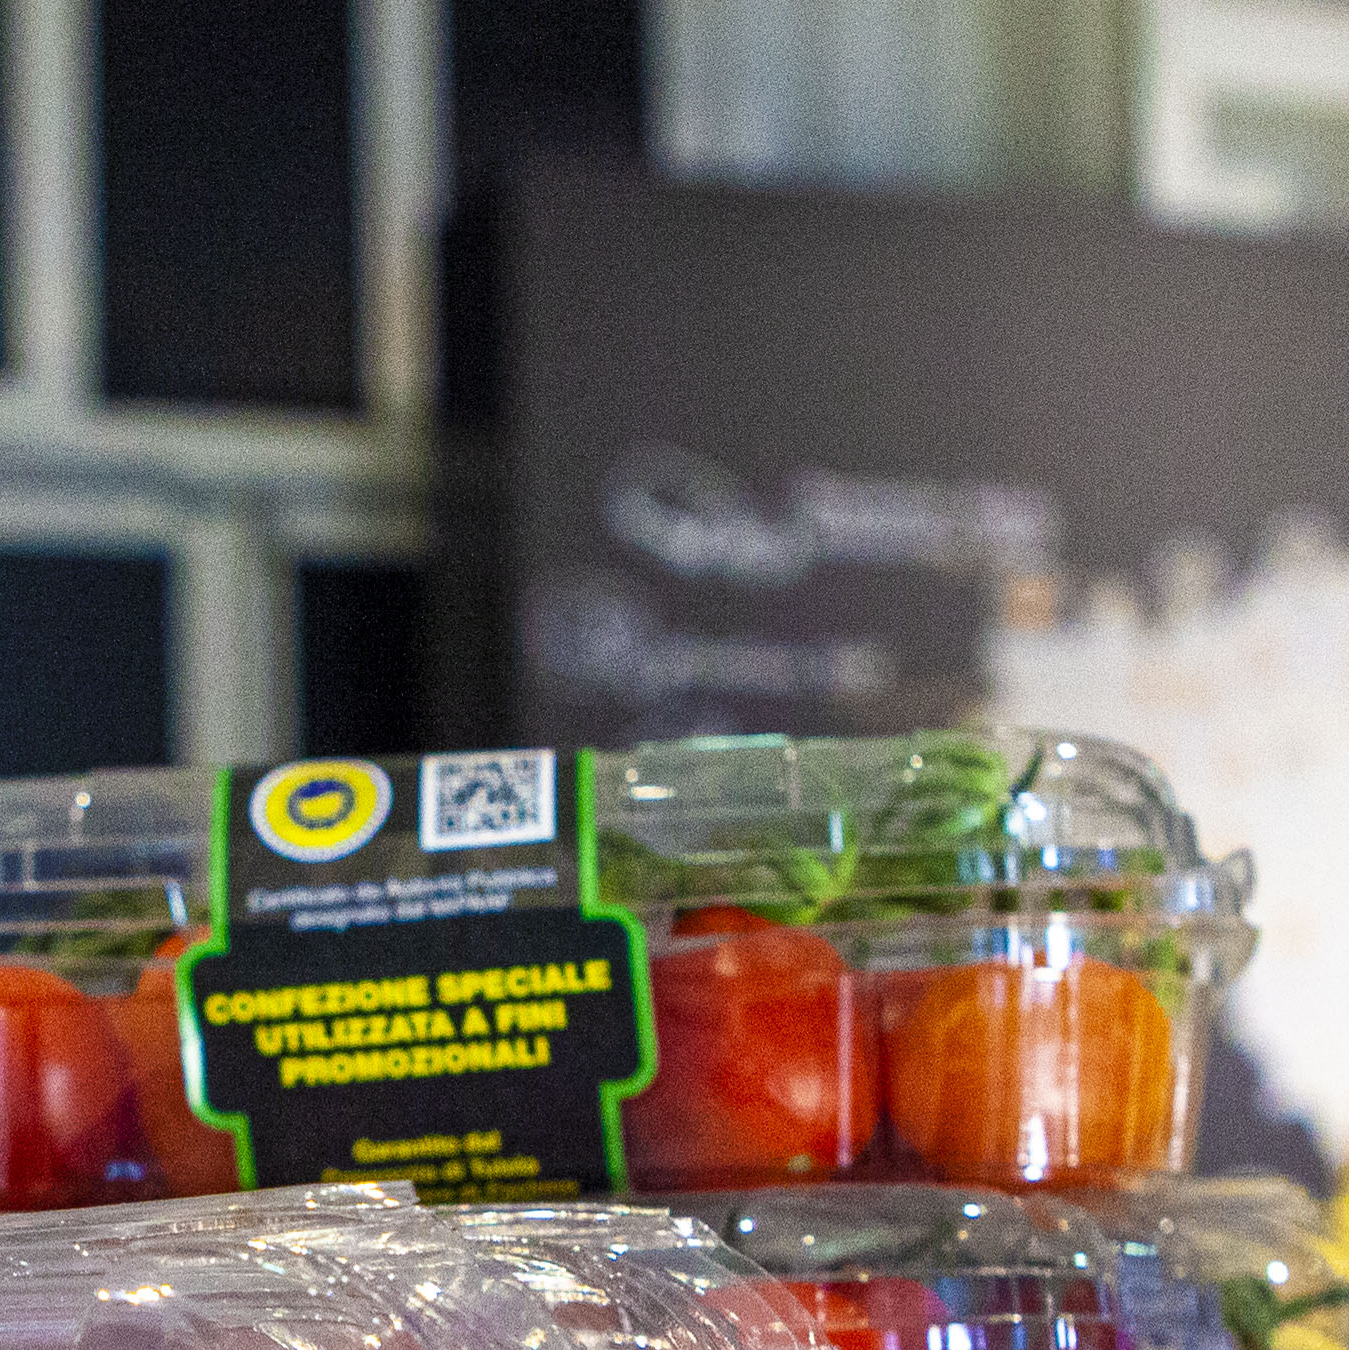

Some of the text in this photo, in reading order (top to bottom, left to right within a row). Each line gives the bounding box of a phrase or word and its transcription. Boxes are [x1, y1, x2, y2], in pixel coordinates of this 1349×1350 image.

[205, 959, 611, 1025] CONFEZIONE SPECIALE
[255, 1000, 568, 1056] UTILIZZATA A FINI
[279, 1034, 551, 1088] PROMOZIONALI
